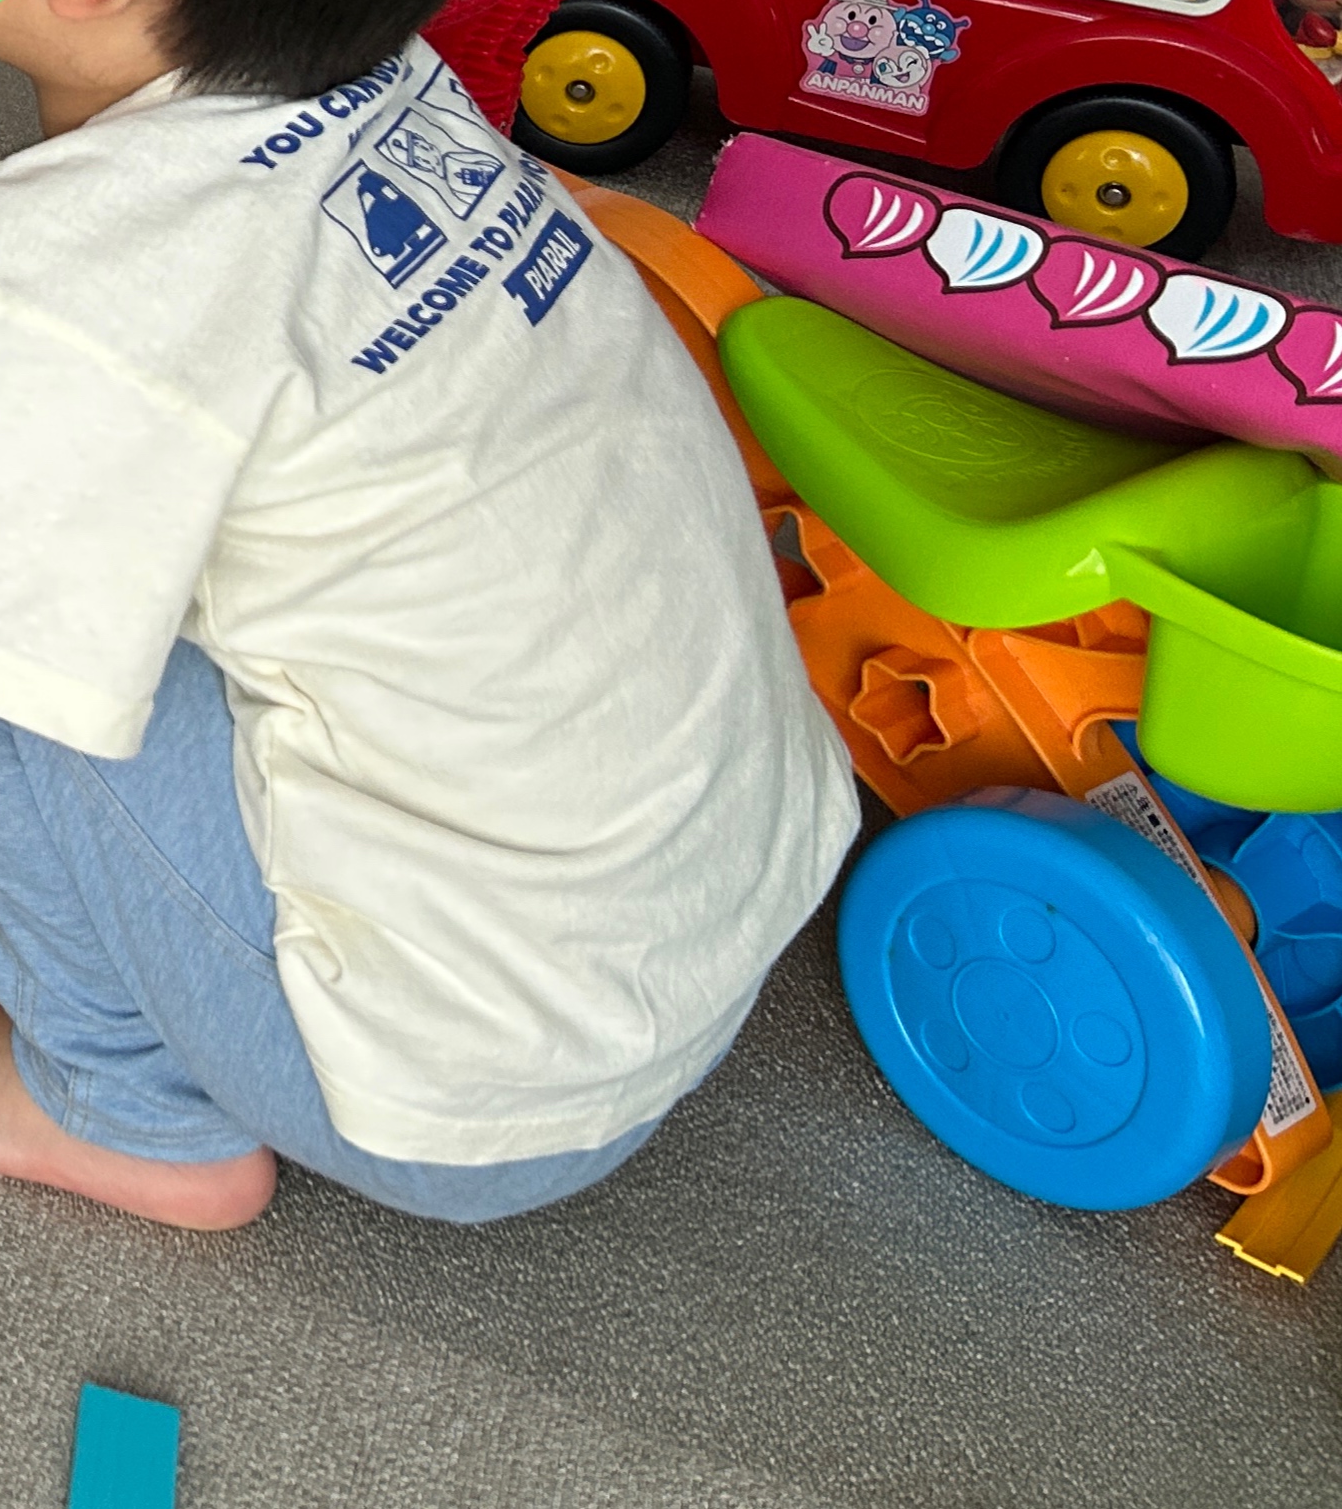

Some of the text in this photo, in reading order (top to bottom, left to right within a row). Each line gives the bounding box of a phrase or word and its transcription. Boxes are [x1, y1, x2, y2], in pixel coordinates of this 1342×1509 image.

[807, 73, 925, 110] ANPANMAN
[239, 111, 325, 170] YOU
[523, 227, 582, 301] PLARAIL
[350, 254, 491, 375] WELCOME
[469, 226, 514, 261] TO
